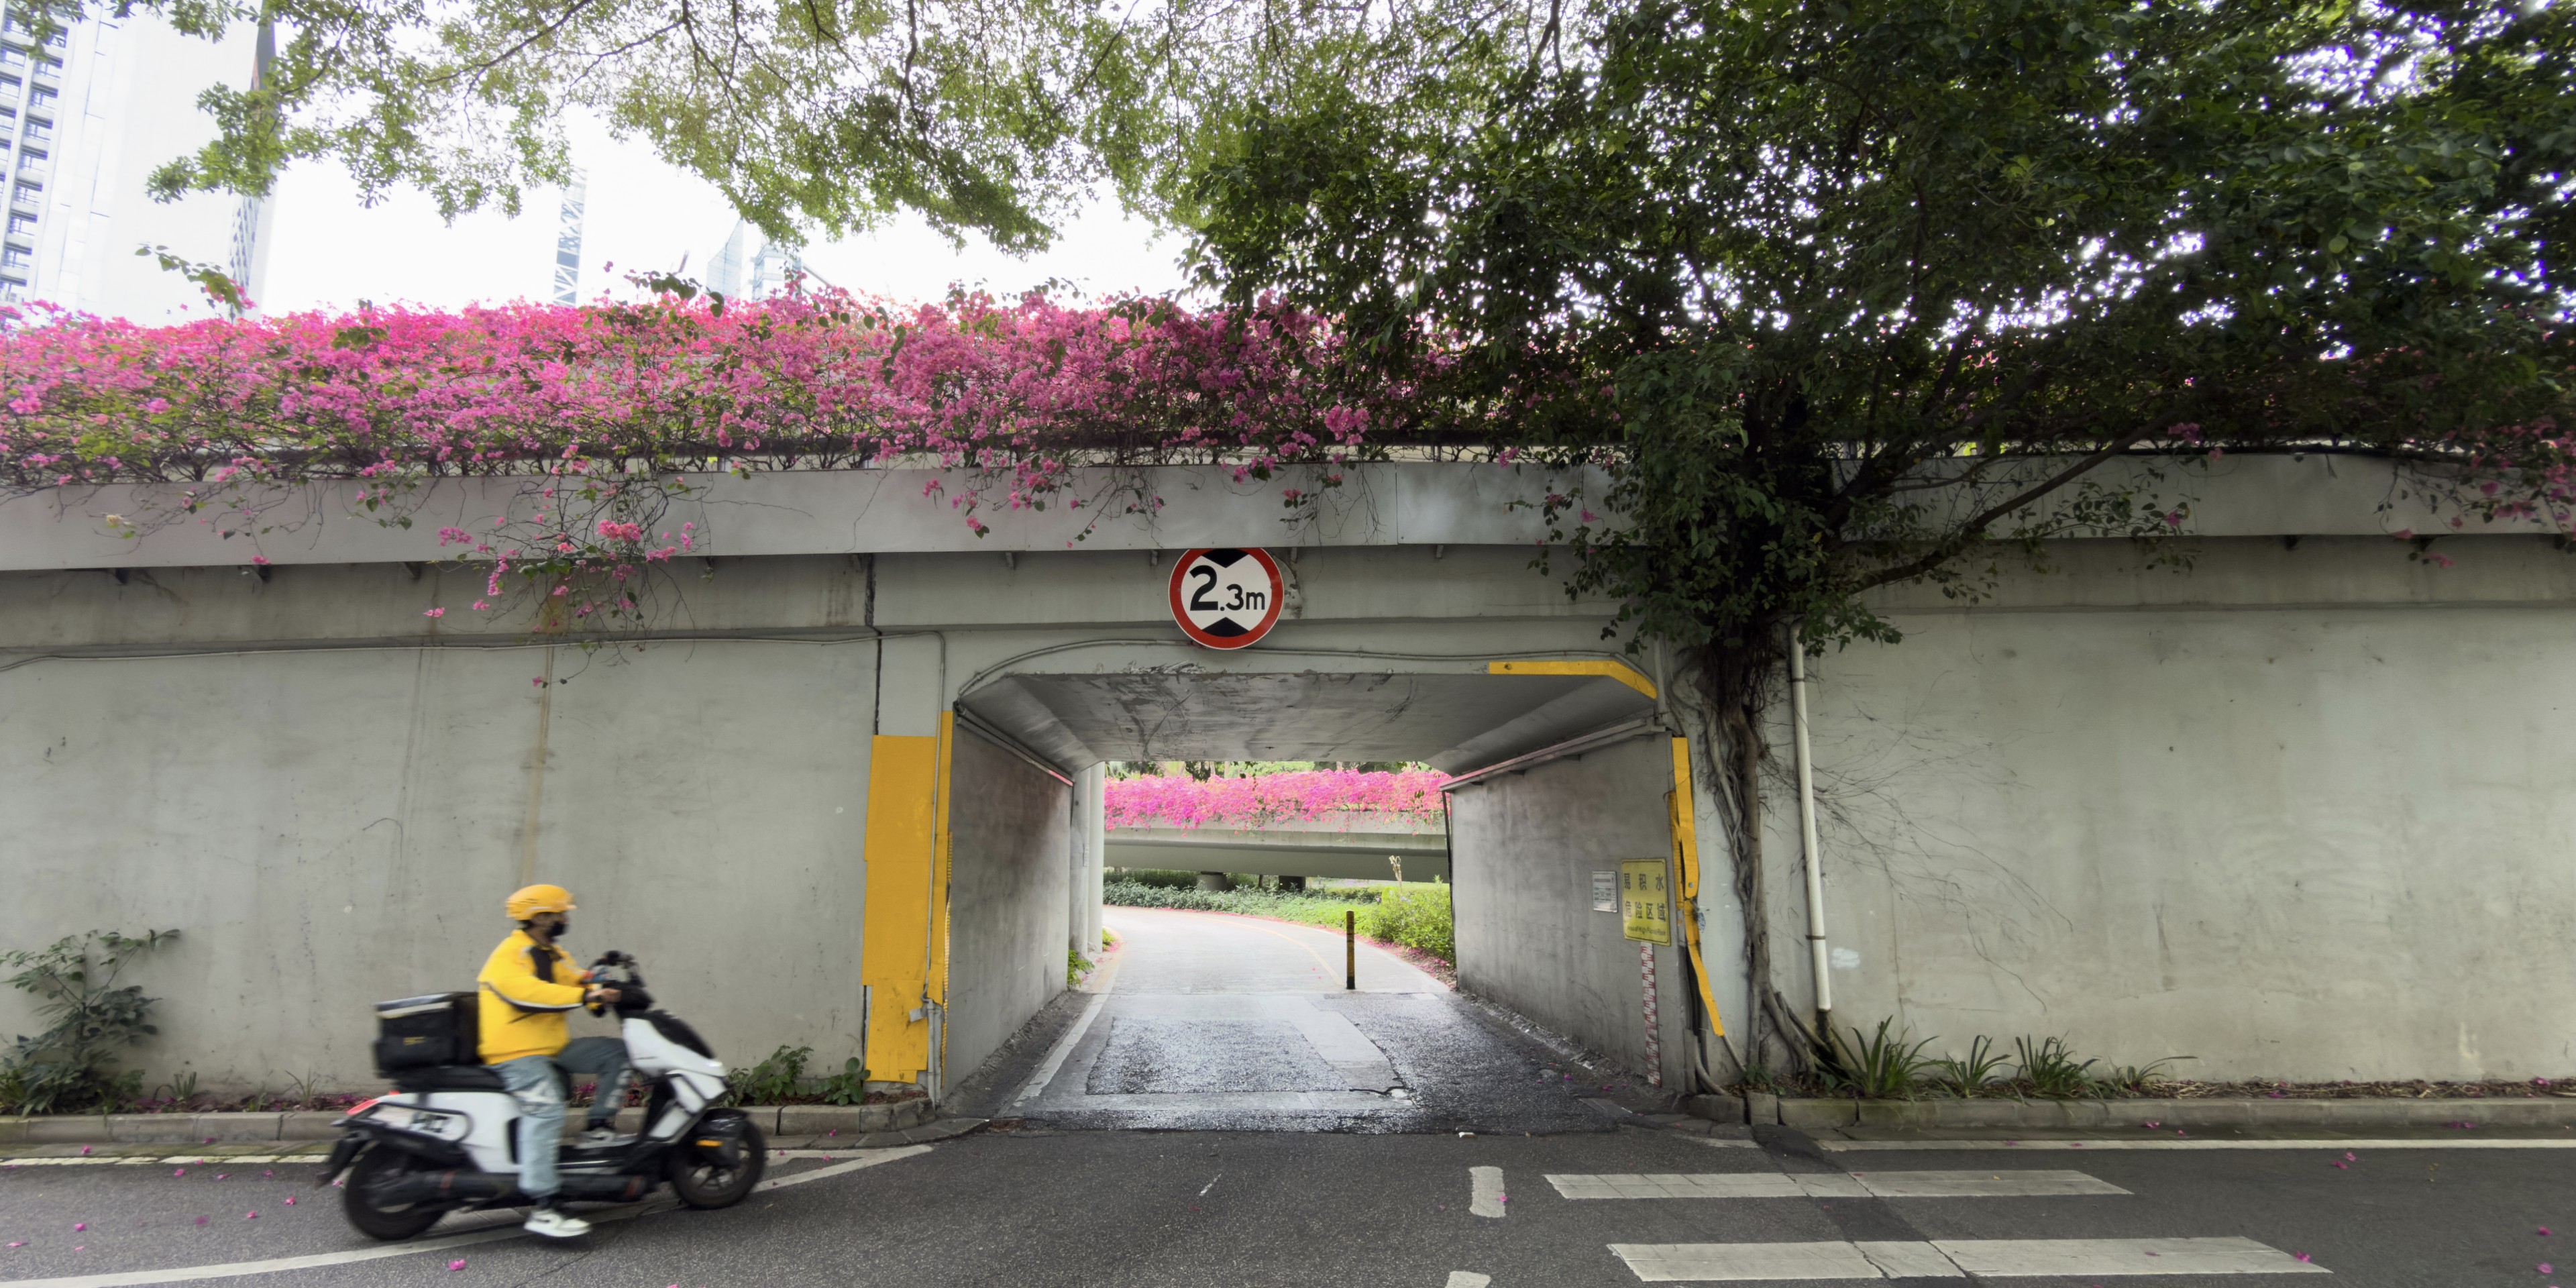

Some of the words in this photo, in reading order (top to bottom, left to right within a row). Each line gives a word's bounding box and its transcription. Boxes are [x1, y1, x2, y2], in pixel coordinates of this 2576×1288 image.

[1189, 564, 1265, 611] 2.3m
[1625, 900, 1666, 922] 危险区域
